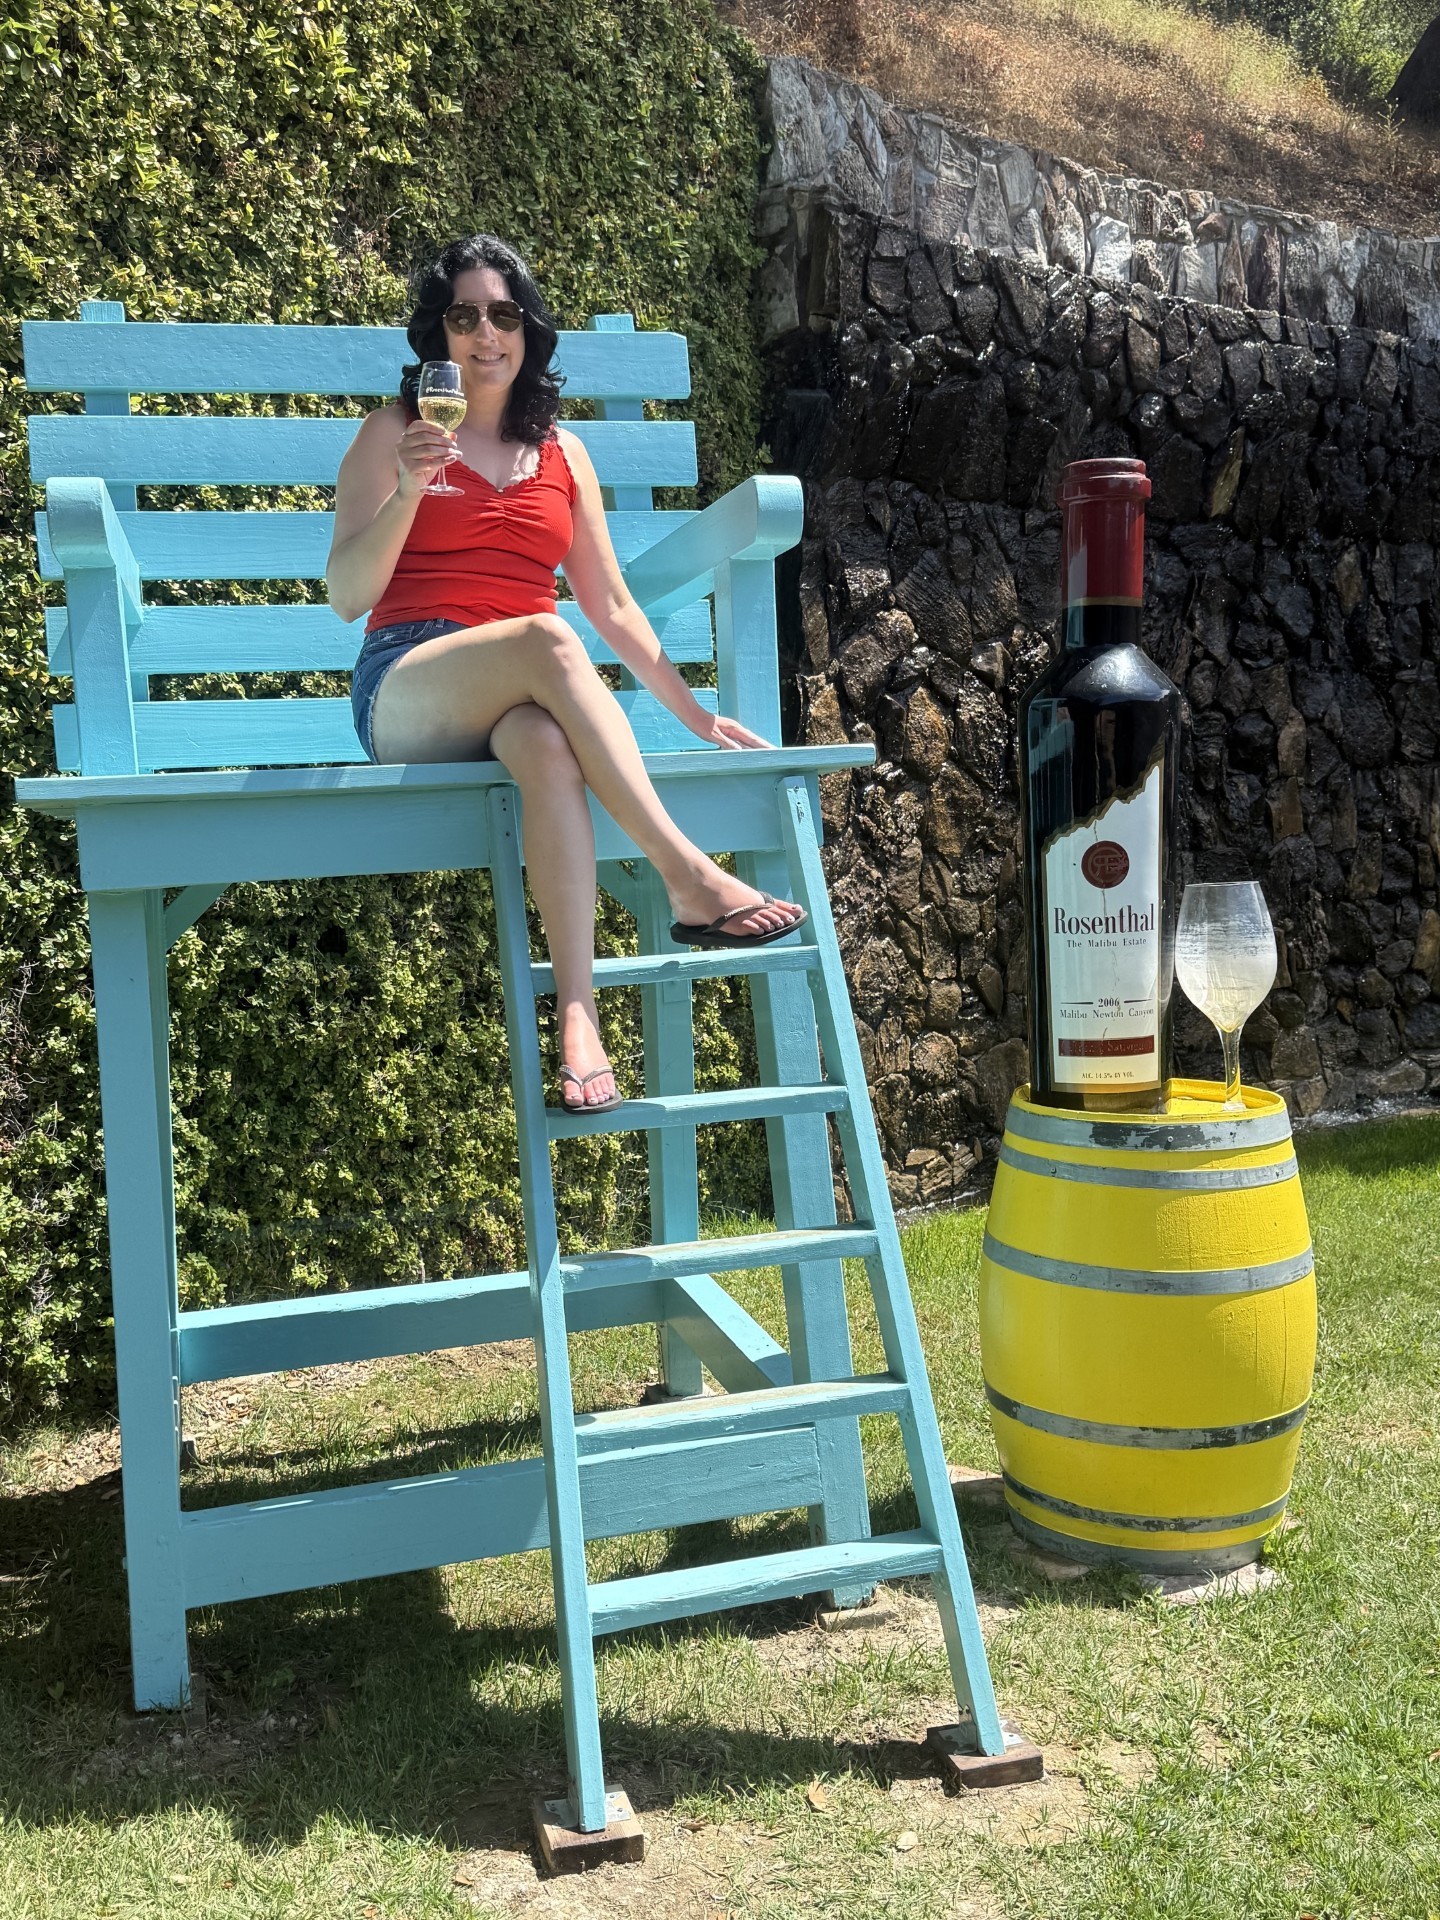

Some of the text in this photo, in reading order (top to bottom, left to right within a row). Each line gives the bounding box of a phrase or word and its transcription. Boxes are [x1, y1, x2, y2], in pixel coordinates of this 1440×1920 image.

[1054, 903, 1155, 935] Rosenthal
[1067, 938, 1147, 948] The Malibu Estate
[1098, 997, 1120, 1008] 2006
[1060, 1007, 1154, 1019] Malibu Newton Canyon
